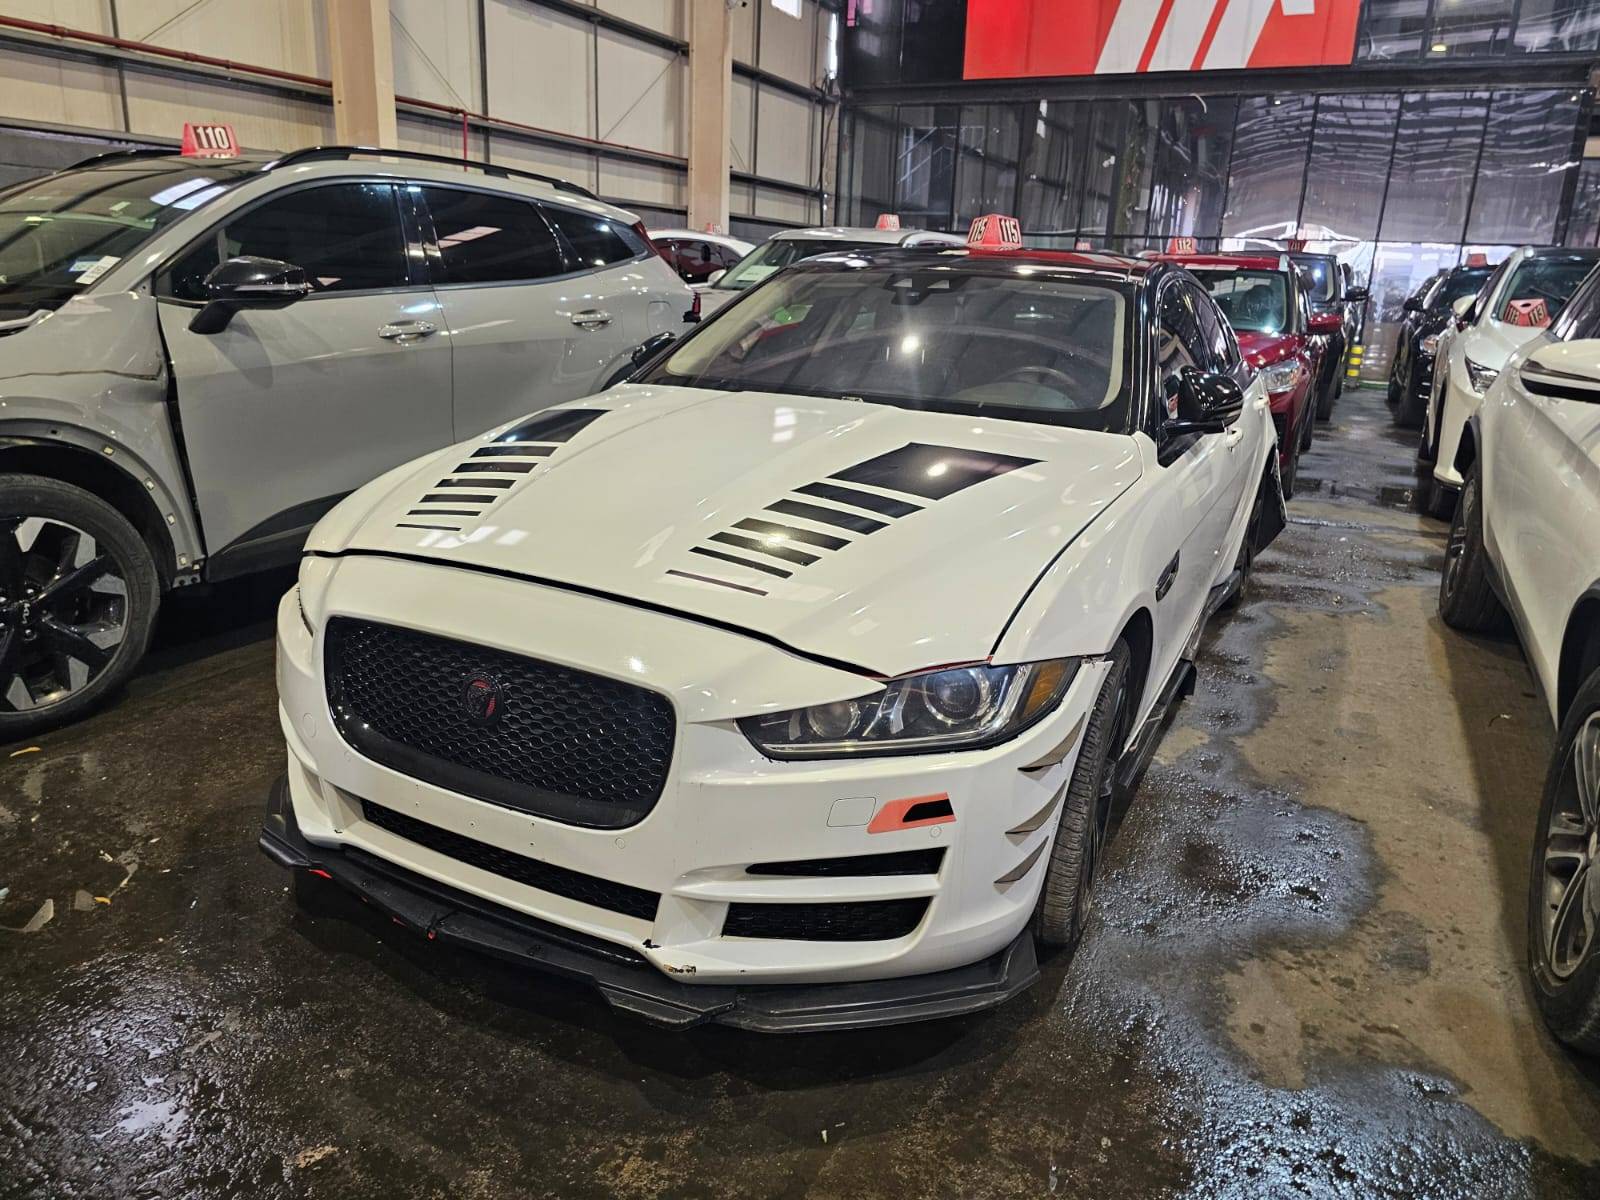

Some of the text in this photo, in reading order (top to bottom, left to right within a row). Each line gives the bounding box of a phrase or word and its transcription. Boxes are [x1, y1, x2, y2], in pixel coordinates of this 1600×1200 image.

[196, 126, 230, 149] 110
[969, 217, 989, 242] 115
[1000, 219, 1019, 243] 115
[1178, 238, 1192, 250] 112
[1530, 303, 1544, 326] 113
